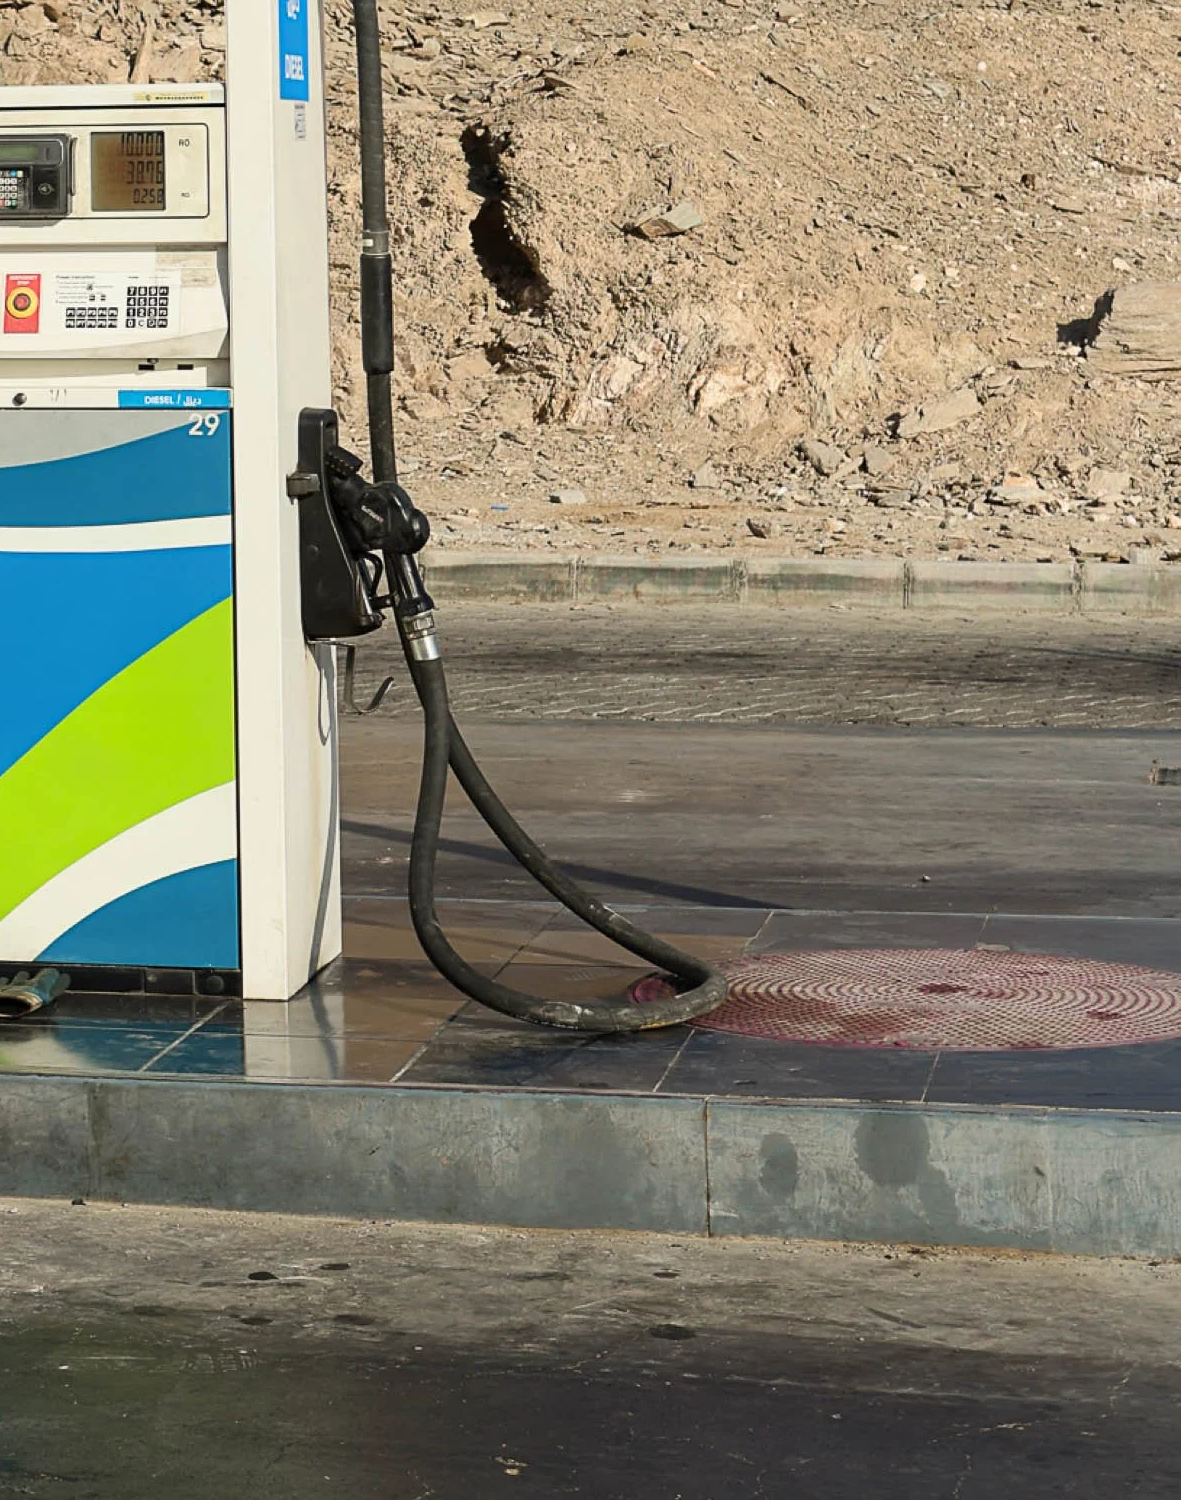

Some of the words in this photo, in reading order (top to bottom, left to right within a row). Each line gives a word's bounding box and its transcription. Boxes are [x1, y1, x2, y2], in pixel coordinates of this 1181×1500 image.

[285, 53, 304, 80] DIESEL
[144, 395, 175, 405] DIESEL
[188, 412, 220, 436] 29
